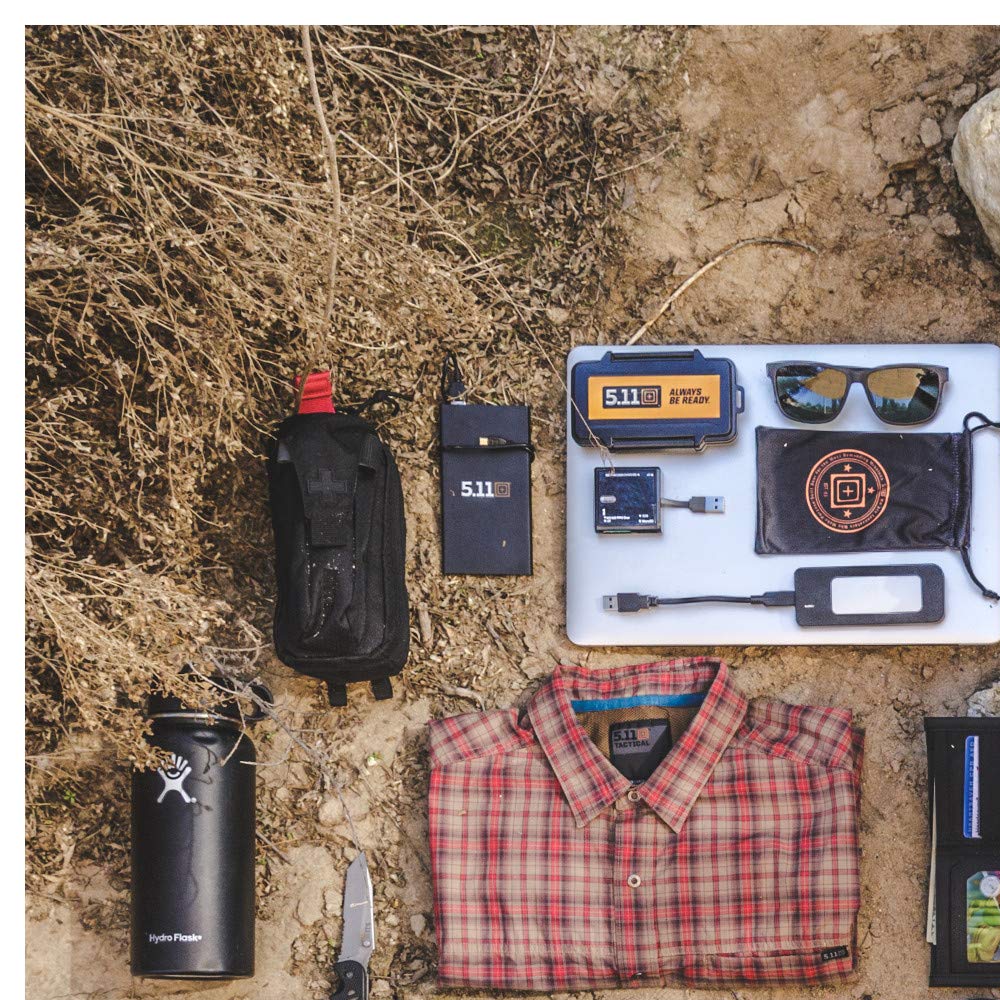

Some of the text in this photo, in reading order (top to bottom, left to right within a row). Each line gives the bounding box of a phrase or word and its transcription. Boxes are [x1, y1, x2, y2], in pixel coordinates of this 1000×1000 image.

[605, 388, 641, 406] 5.11
[669, 388, 703, 396] ALWAYS
[669, 396, 680, 405] BE
[460, 481, 495, 498] 5.11
[613, 730, 637, 742] 5.11
[614, 740, 651, 749] TACTICAL
[149, 933, 173, 944] Hydro
